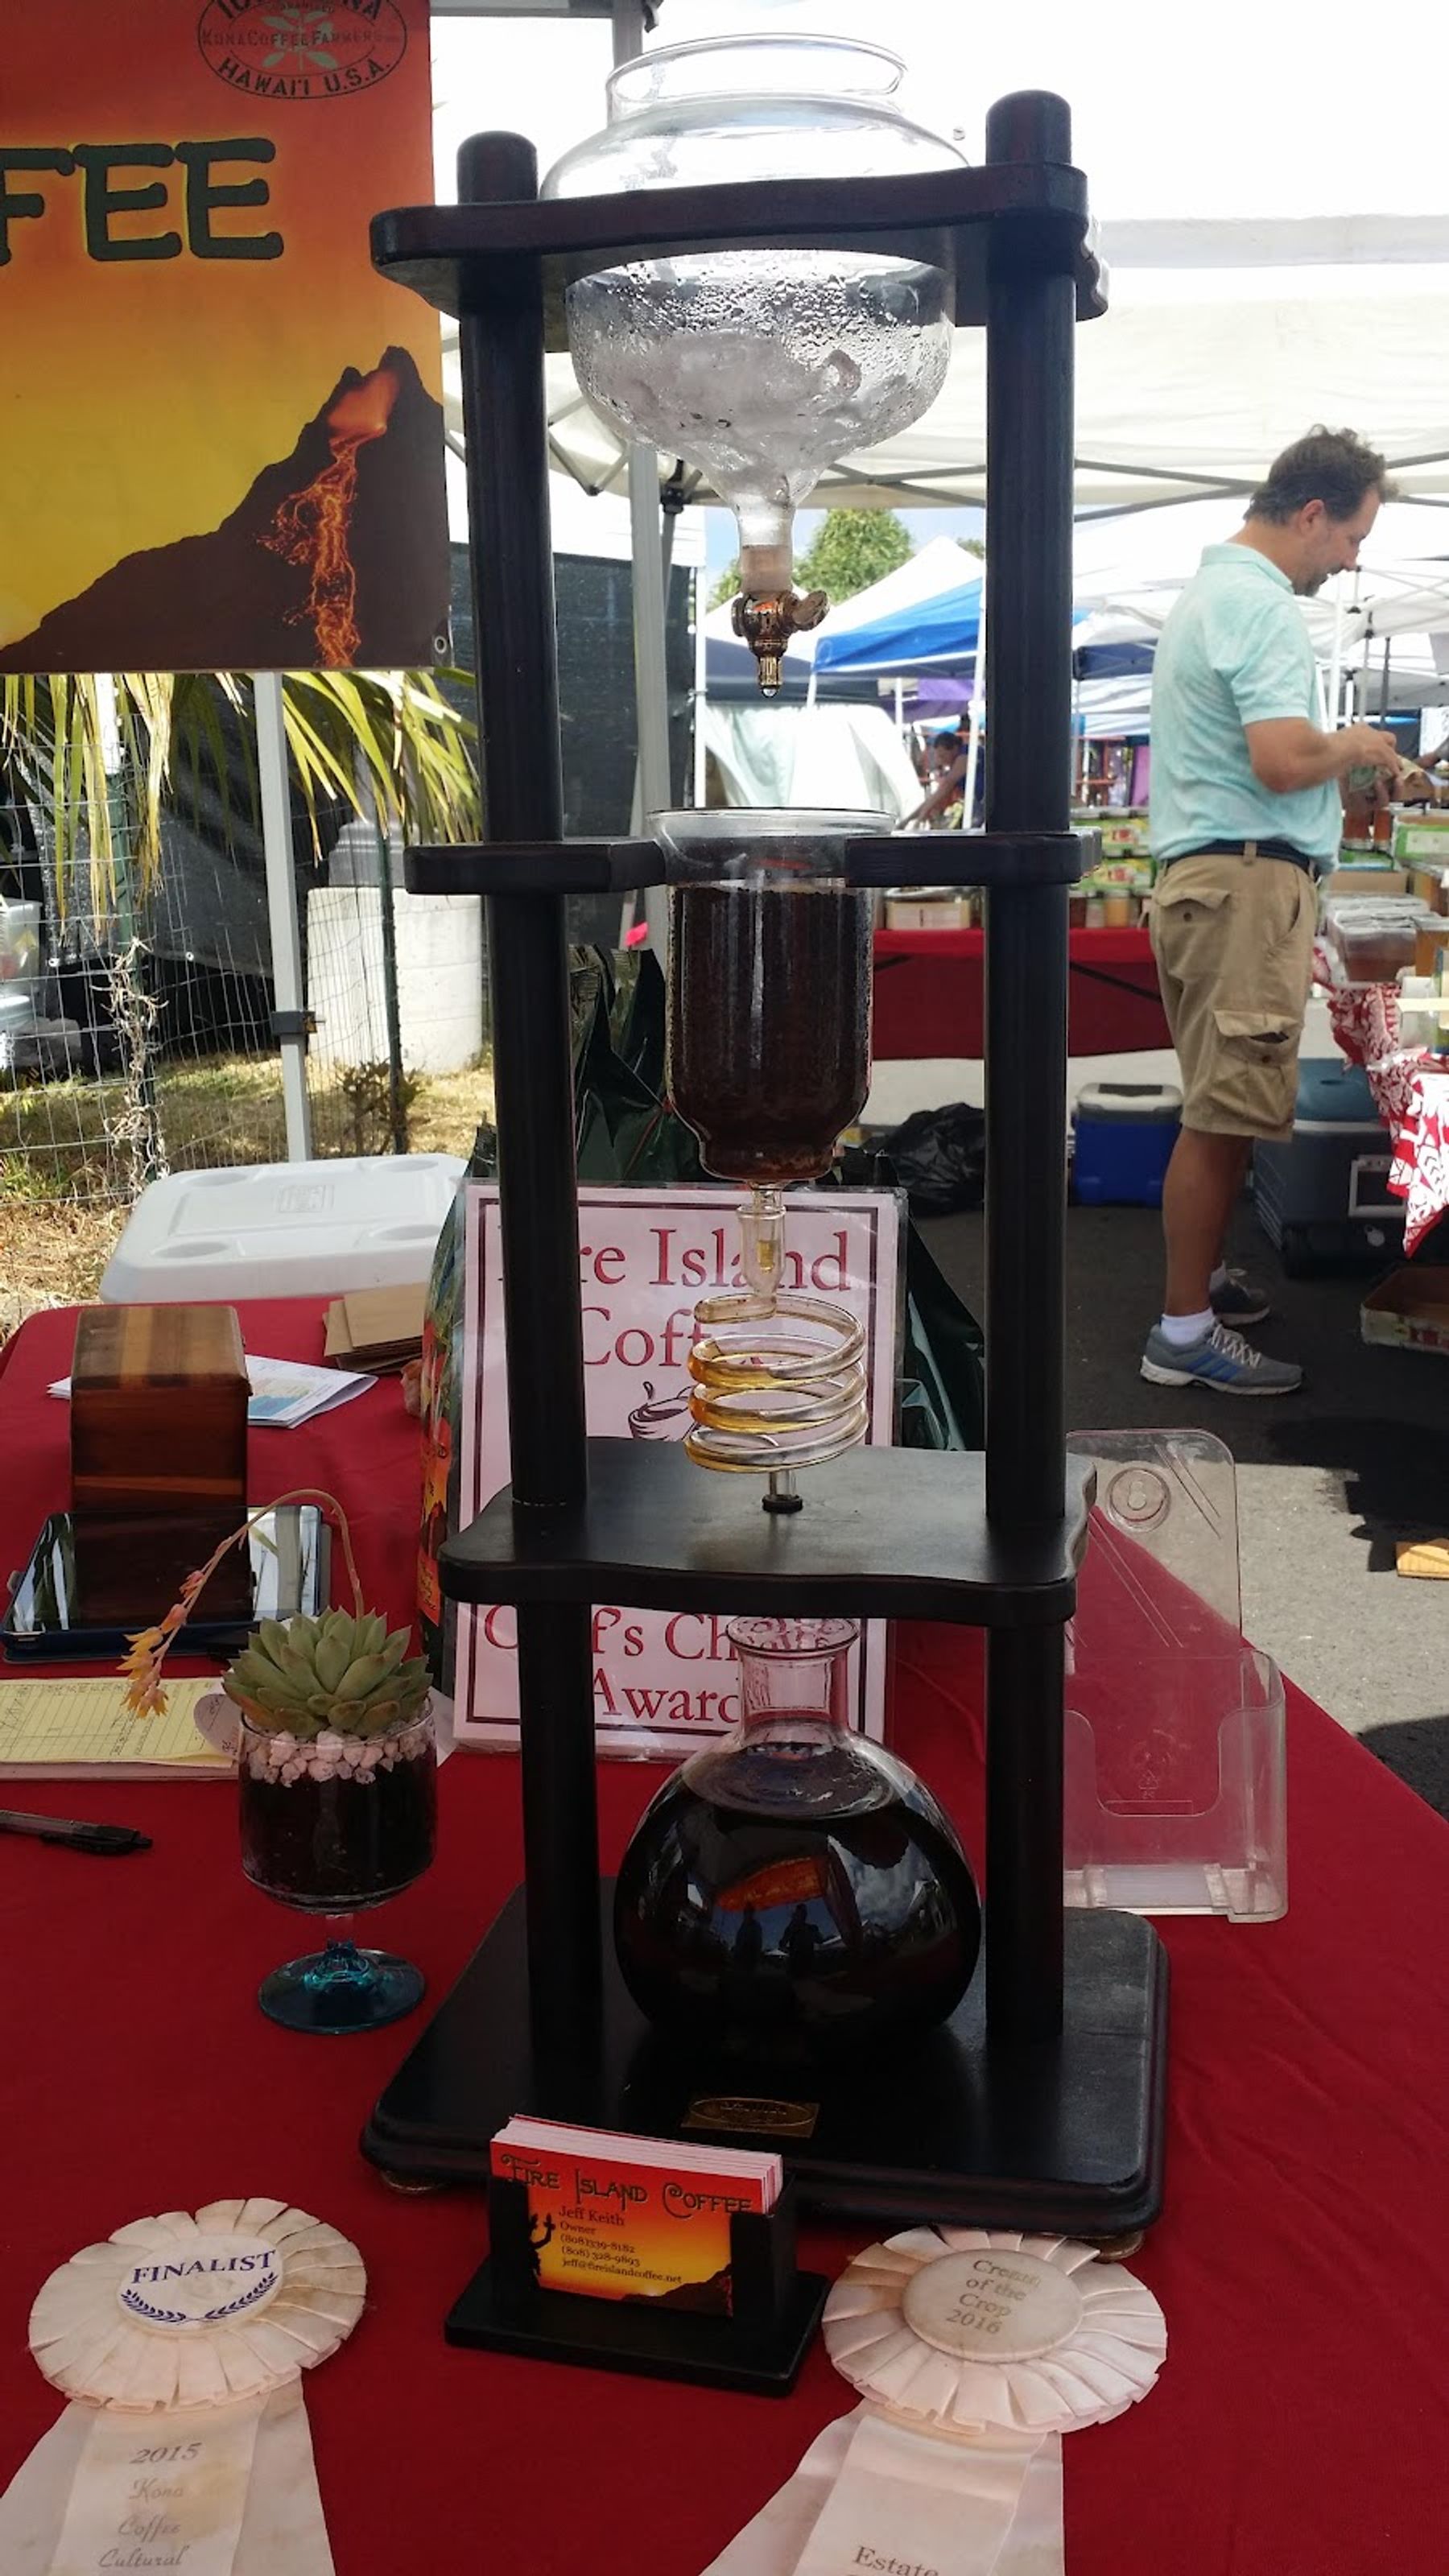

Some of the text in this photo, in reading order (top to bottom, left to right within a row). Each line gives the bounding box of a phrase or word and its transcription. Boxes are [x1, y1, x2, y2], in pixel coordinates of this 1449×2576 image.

[323, 58, 390, 93] U.S.A.
[502, 2153, 753, 2219] FIRE ISLAND COFFEE
[559, 2205, 625, 2227] Jeff Keith
[560, 2220, 597, 2235] Owner
[131, 2249, 277, 2284] FINALIST
[966, 2279, 995, 2290] of
[959, 2293, 1012, 2318] Crop
[945, 2309, 1003, 2334] 2016
[129, 2442, 203, 2464] 2015
[129, 2477, 184, 2503] Kona
[118, 2514, 182, 2543] Coffee
[98, 2545, 190, 2567] Cultural
